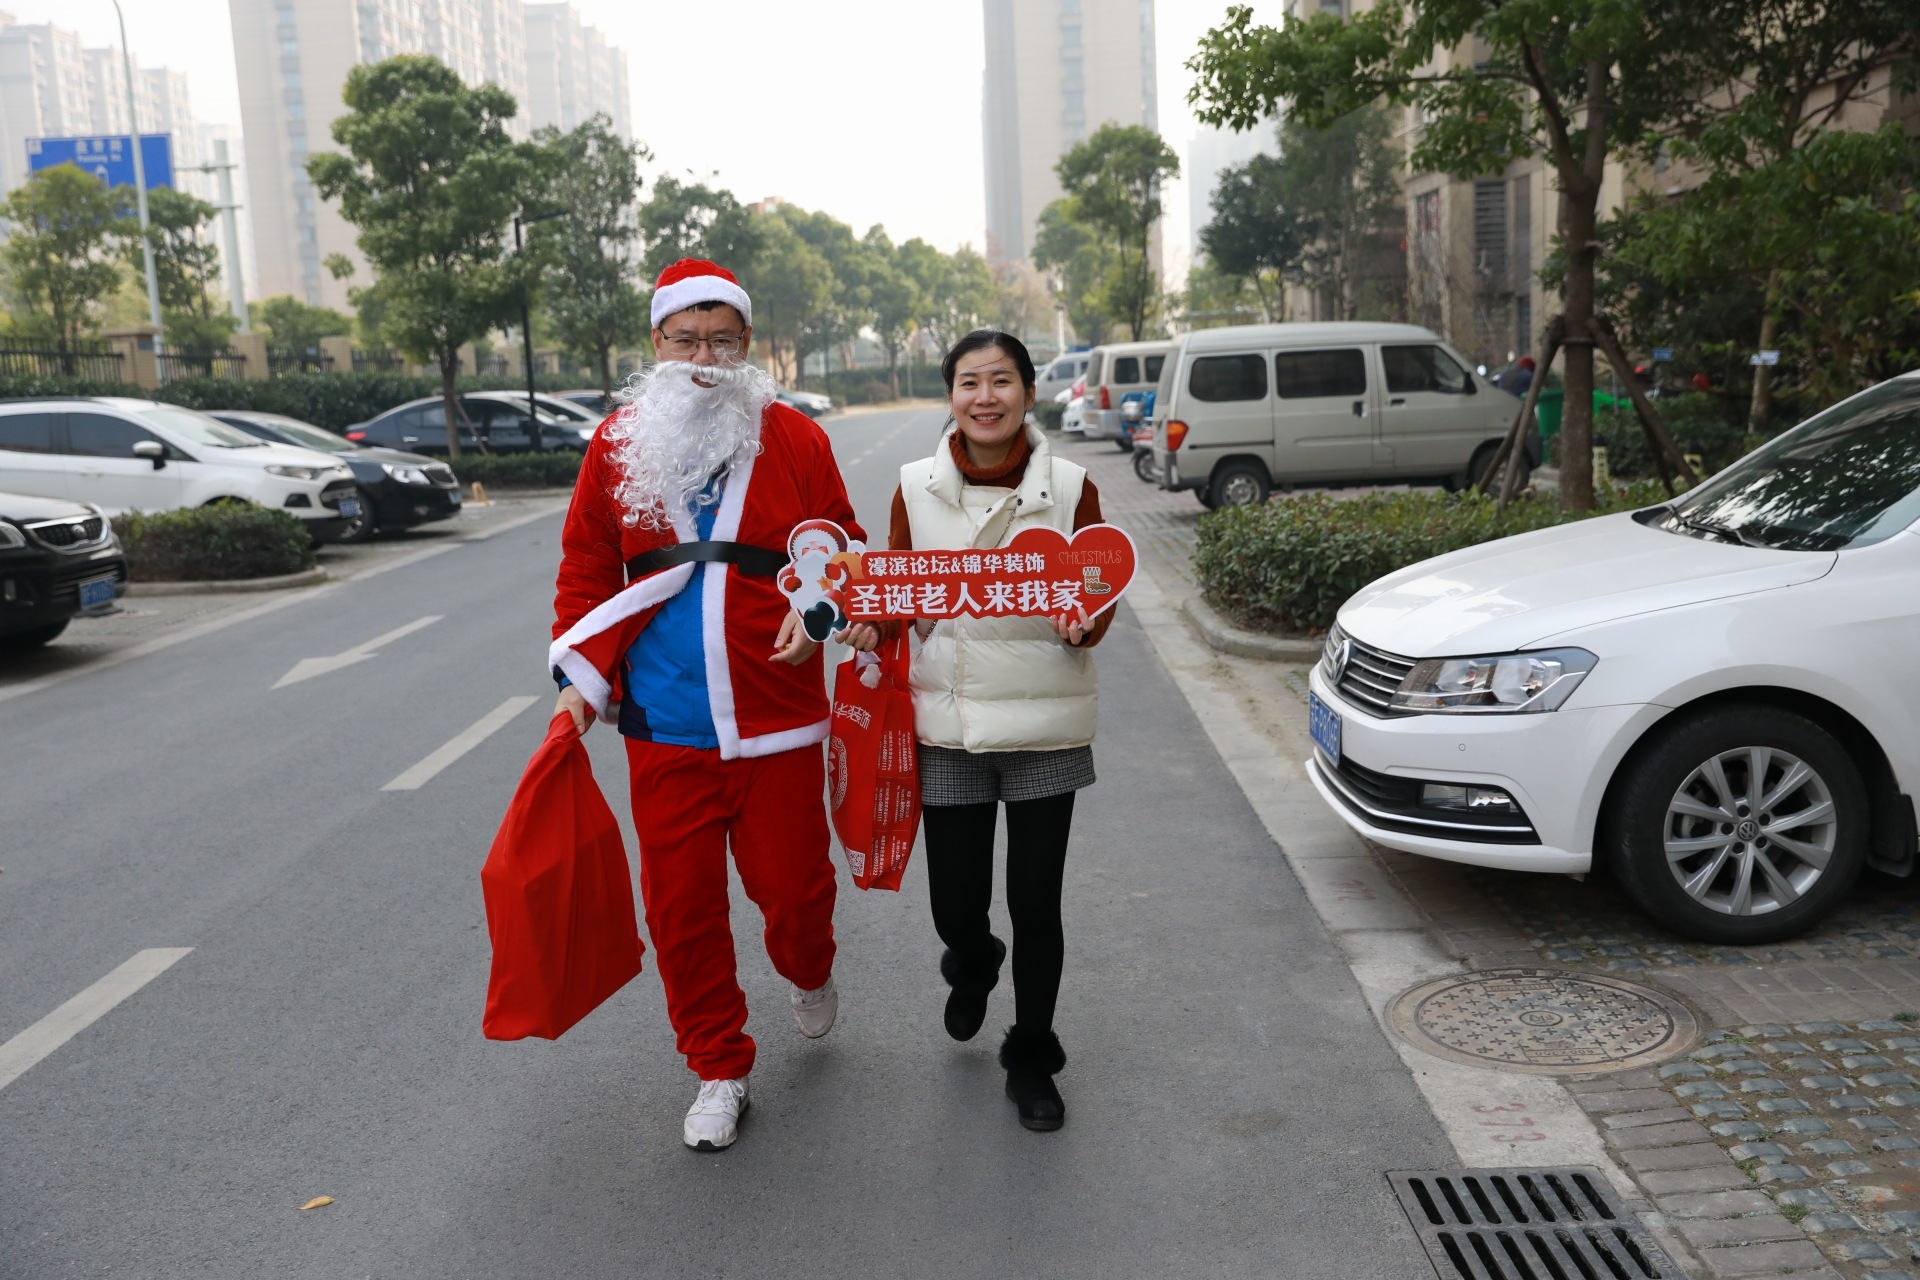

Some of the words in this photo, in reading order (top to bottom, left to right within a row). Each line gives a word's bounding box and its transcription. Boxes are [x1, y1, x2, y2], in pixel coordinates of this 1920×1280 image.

[868, 552, 1045, 577] 濠滨论坛&锦华装饰
[1058, 549, 1122, 565] CHRISTMAS
[850, 579, 1084, 616] 圣诞老人来我家
